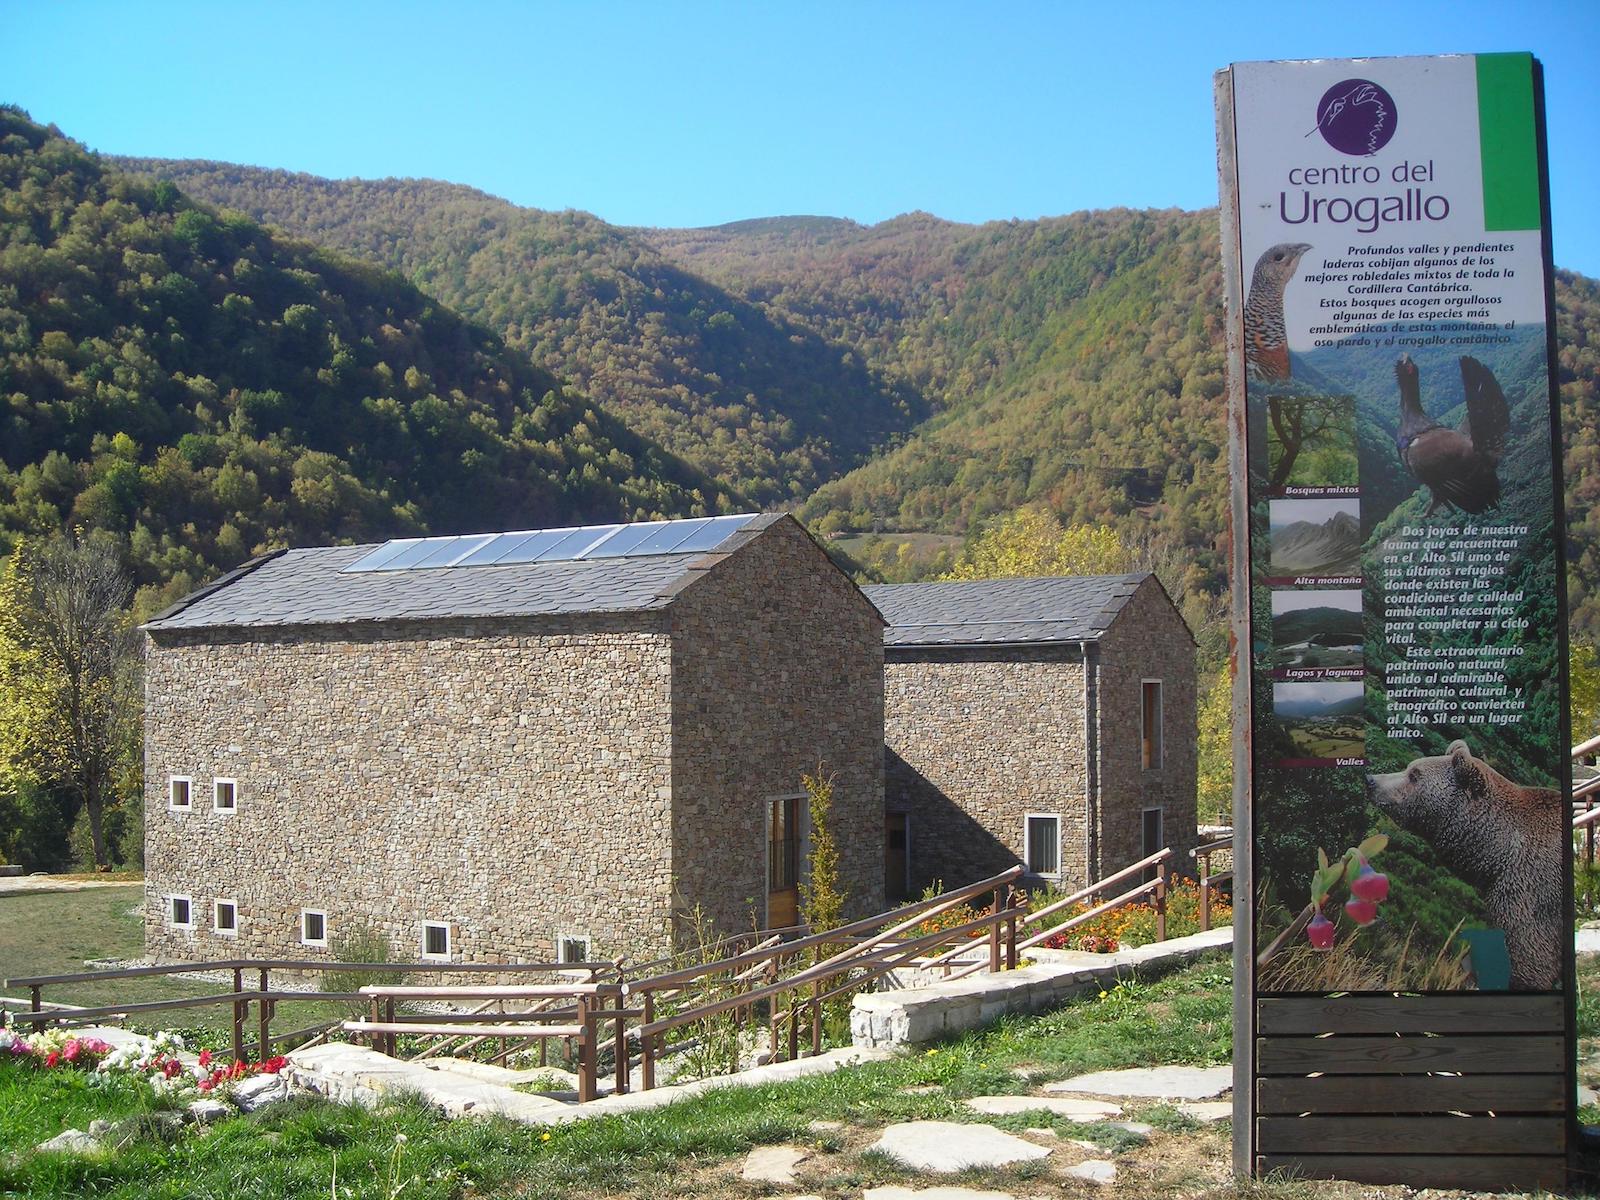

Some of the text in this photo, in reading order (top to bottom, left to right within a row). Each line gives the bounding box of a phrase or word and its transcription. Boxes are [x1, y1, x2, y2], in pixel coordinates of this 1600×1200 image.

[1289, 160, 1433, 185] centro del
[1281, 189, 1450, 233] Urogallo
[1348, 243, 1514, 255] Profundos valles y pendientes
[1323, 256, 1494, 270] laderas cobijan algunos de los
[1305, 268, 1514, 283] mejores robledales mixtos de toda la
[1348, 282, 1472, 294] Cordillera Cantábrica.
[1320, 295, 1502, 309] Estos bosques acogen orgullosos
[1333, 308, 1490, 322] algunas de las especies más
[1310, 323, 1385, 334] emblemáticas
[1391, 322, 1405, 332] de
[1409, 322, 1436, 332] estas
[1504, 321, 1514, 330] el
[1315, 339, 1333, 348] oso
[1337, 337, 1371, 349] pardo
[1375, 338, 1381, 347] y
[1385, 336, 1395, 346] el
[1398, 335, 1446, 347] urogallo
[1286, 486, 1359, 496] Bosques mixtos
[1402, 525, 1527, 538] Dos joyas de nuestra
[1384, 539, 1518, 551] fauna que encuentran
[1384, 551, 1510, 563] en el Alto Sil uno de
[1384, 566, 1504, 578] sus últimos refugios
[1385, 578, 1490, 590] donde existen las
[1385, 591, 1523, 603] condiciones de calidad
[1385, 606, 1514, 617] ambiental necesarias
[1385, 618, 1529, 633] para completar su ciclo
[1386, 634, 1416, 644] vital.
[1406, 645, 1524, 657] Este extraordinario
[1386, 659, 1508, 673] patrimonio natural,
[1286, 668, 1364, 678] Lagos y lagunas
[1387, 672, 1504, 684] unido al admirable
[1387, 686, 1522, 700] patrimonio cultural y
[1387, 700, 1525, 712] etnográfico convierten
[1387, 713, 1522, 725] al Alto Sil en un lugar
[1387, 727, 1424, 738] único.
[1336, 758, 1364, 766] Valles
